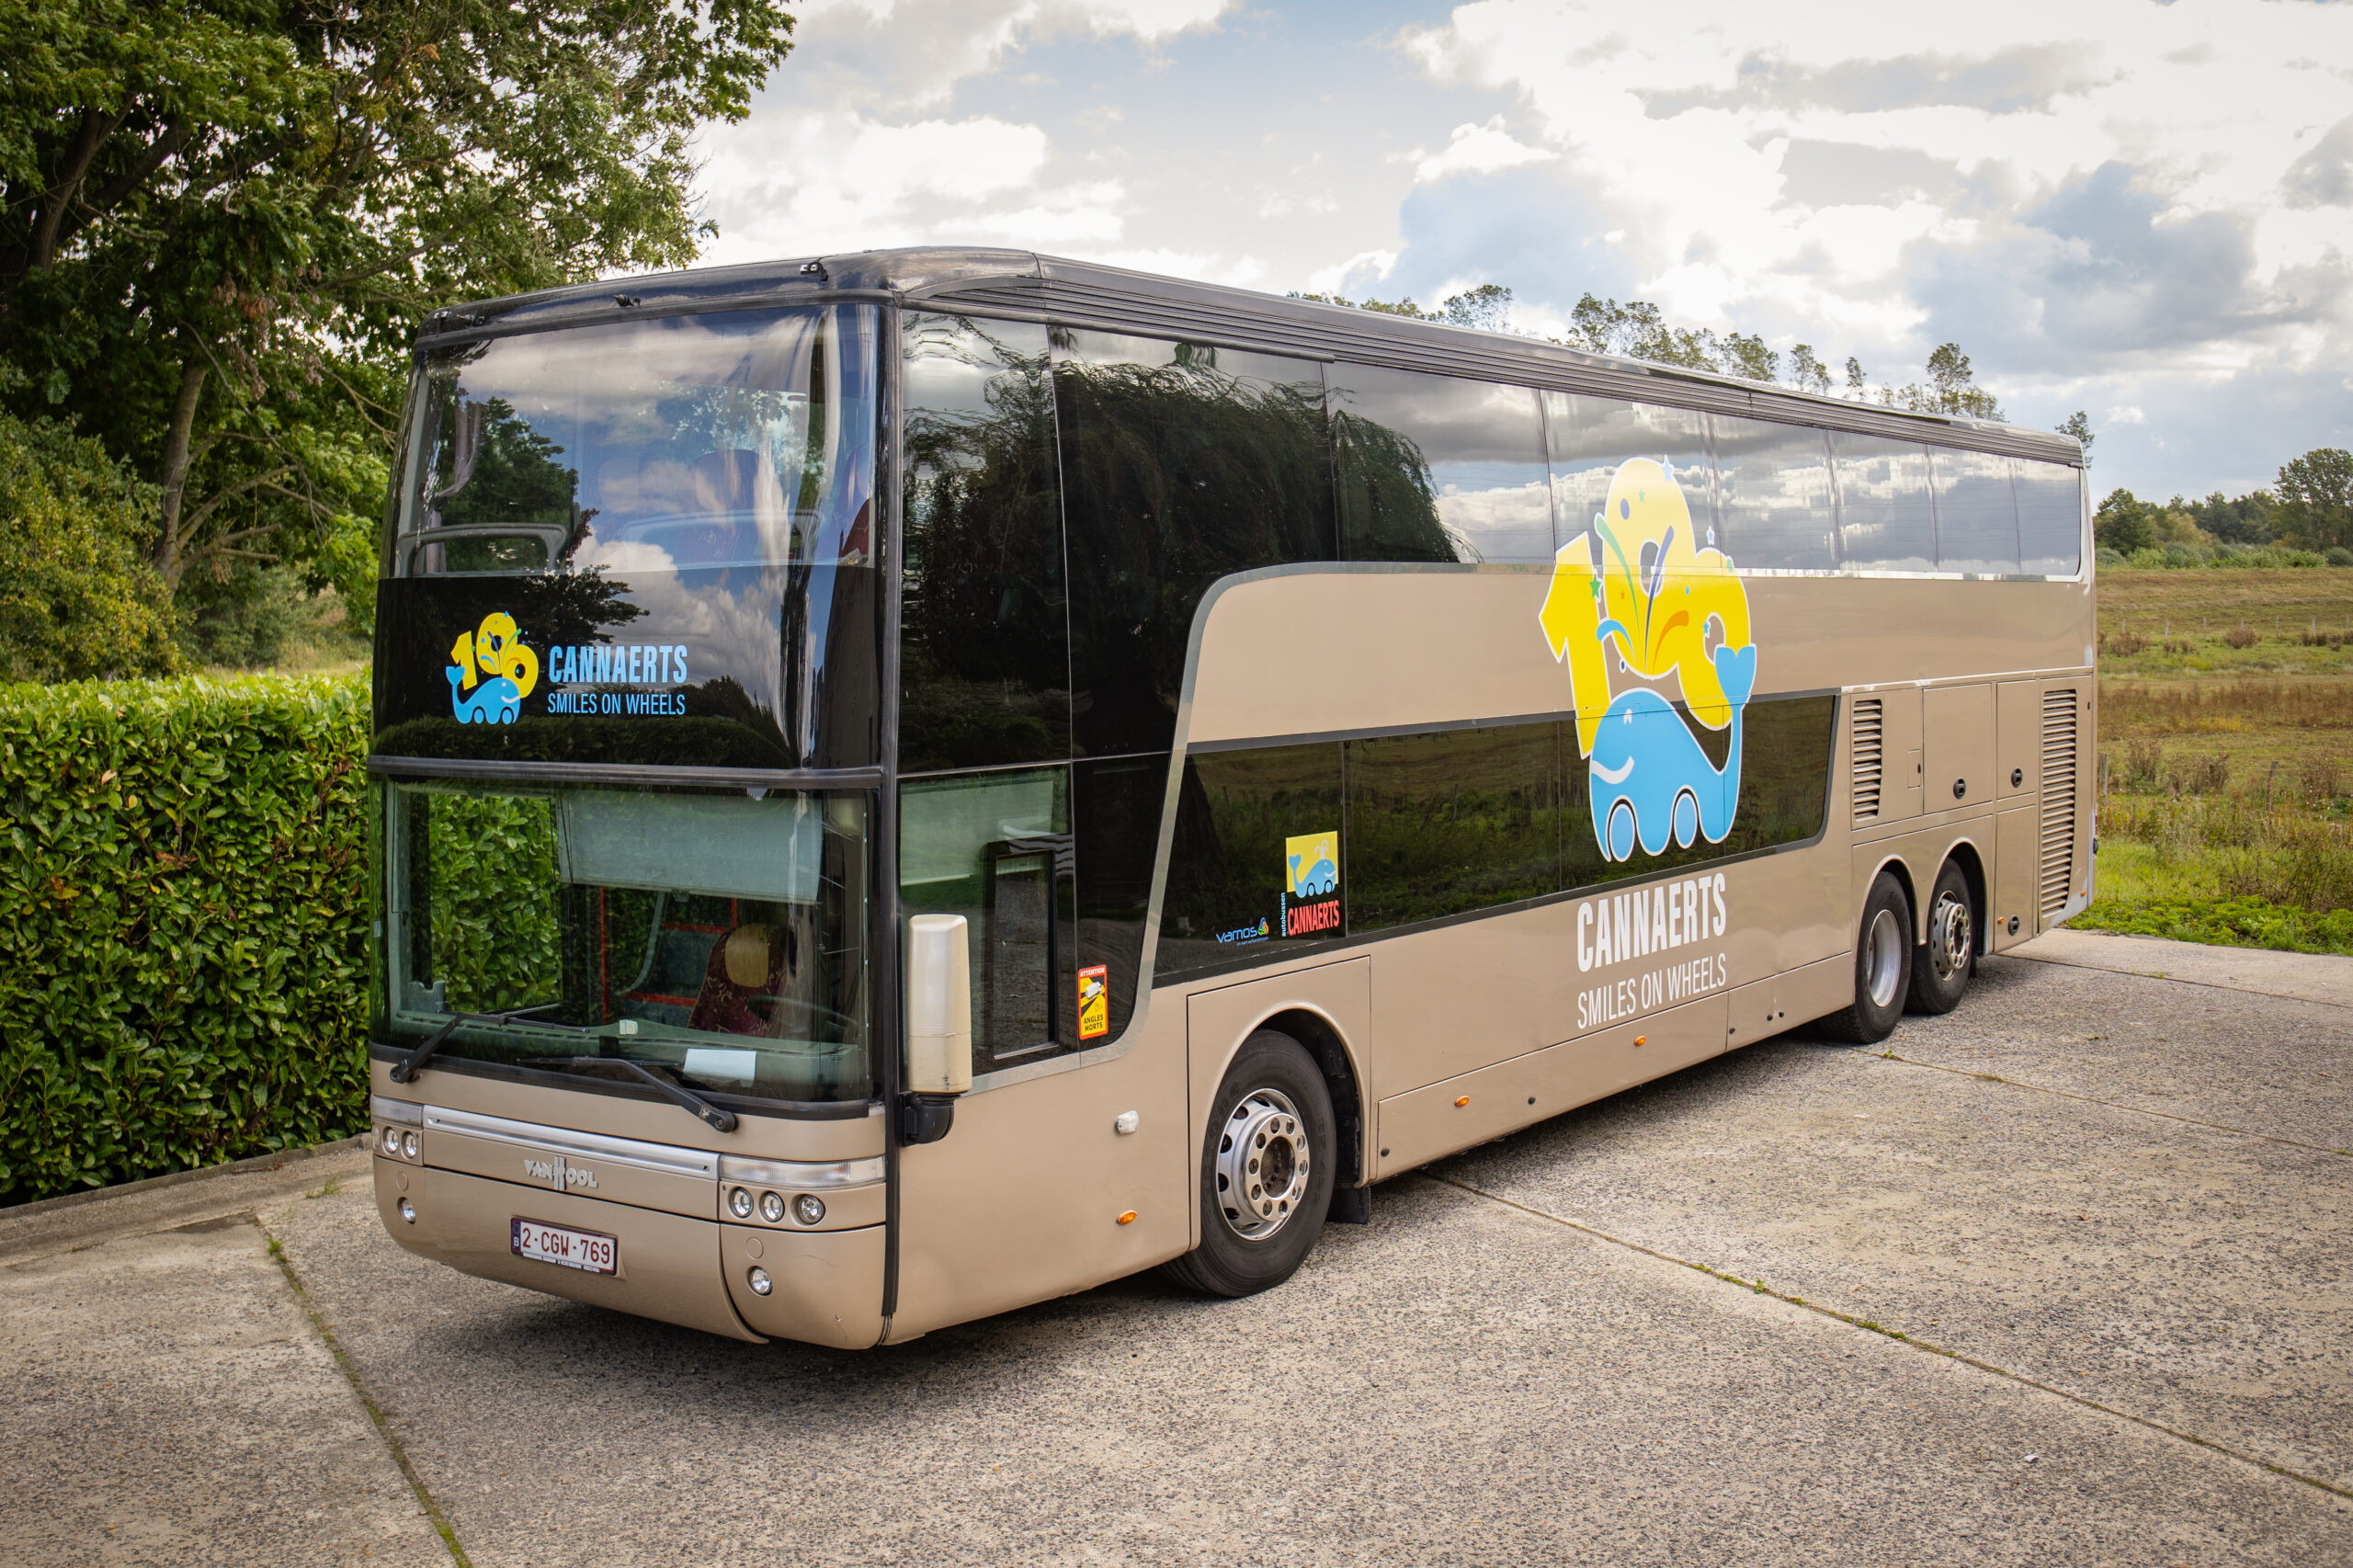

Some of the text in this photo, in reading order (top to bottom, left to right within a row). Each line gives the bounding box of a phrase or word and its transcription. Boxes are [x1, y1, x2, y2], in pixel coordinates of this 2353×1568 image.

[549, 645, 688, 684] CANNAERTS
[548, 692, 686, 715] SMILES ON WHEELS
[1287, 899, 1340, 937] CANNAERTS
[1577, 872, 1727, 972] CANNAERTS
[1577, 952, 1727, 1029] SMILES ON WHEELS
[1084, 1014, 1104, 1025] ANGLES
[1085, 1022, 1103, 1031] MORTS
[513, 1236, 520, 1247] B
[522, 1227, 610, 1265] 2-CGW-769
